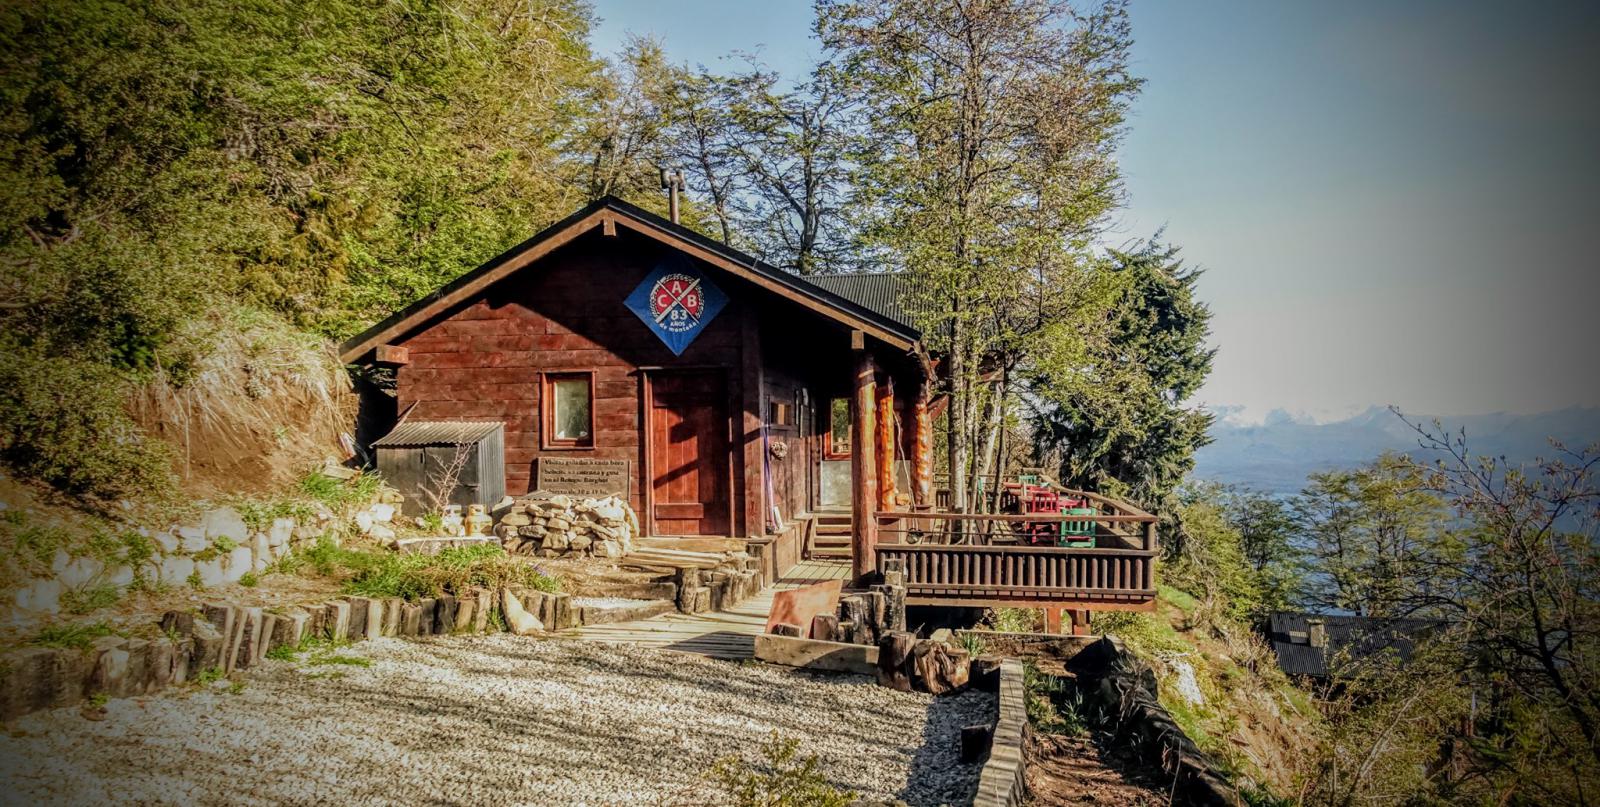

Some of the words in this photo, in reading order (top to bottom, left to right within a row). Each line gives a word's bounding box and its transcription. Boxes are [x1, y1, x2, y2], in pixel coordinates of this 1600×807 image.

[671, 281, 683, 294] A
[657, 294, 668, 307] C
[687, 294, 697, 307] B
[670, 309, 688, 321] 83
